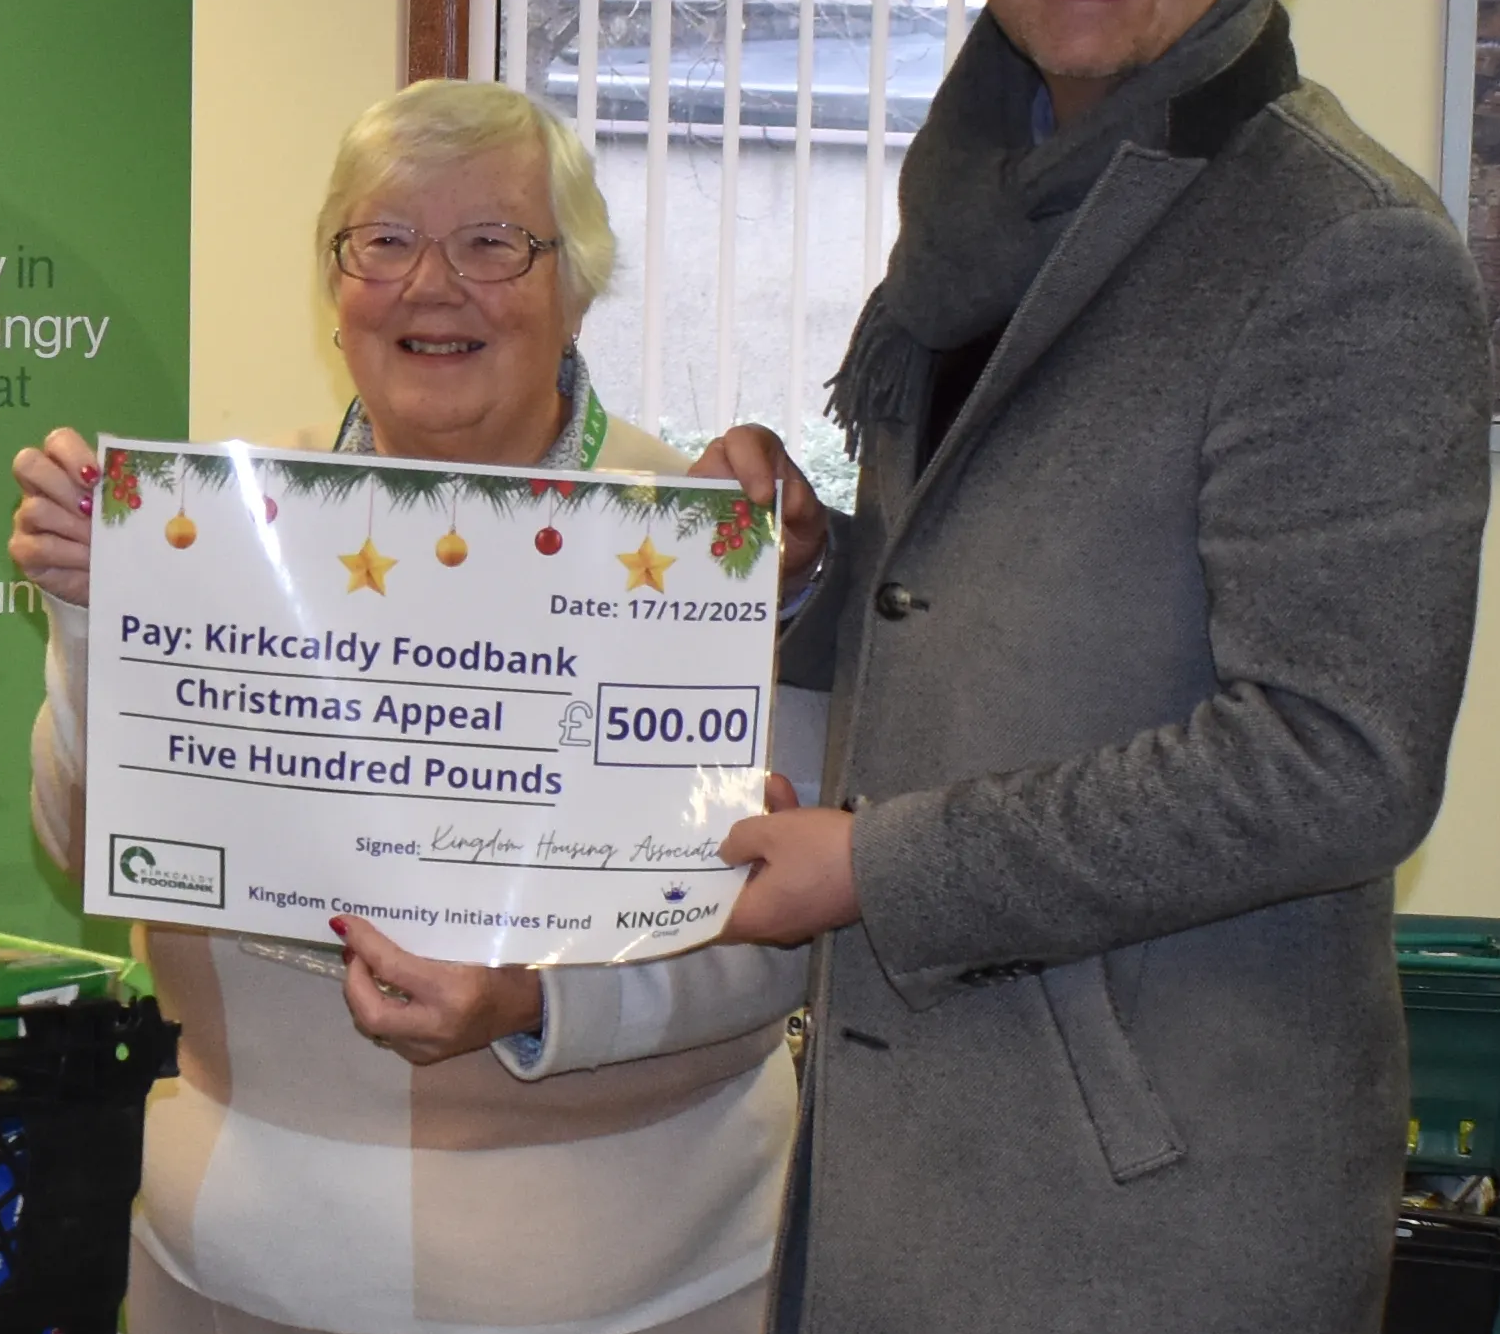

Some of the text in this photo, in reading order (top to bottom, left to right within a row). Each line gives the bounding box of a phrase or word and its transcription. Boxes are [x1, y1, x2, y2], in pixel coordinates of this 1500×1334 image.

[16, 243, 54, 289] in
[550, 593, 768, 623] Date: 17/12/2025
[120, 614, 578, 679] Pay: Kirkcaldy Foodbank
[175, 677, 503, 736] Christmas Appeal
[558, 700, 749, 748] £ 500.00
[168, 734, 563, 796] Five Hundred Pounds
[355, 824, 720, 869] Signed: Kingdom Housing Associati
[140, 876, 215, 895] FOODBANK
[247, 885, 593, 931] Kingdom Community Initiatives Fund
[615, 902, 720, 930] KINGDOM
